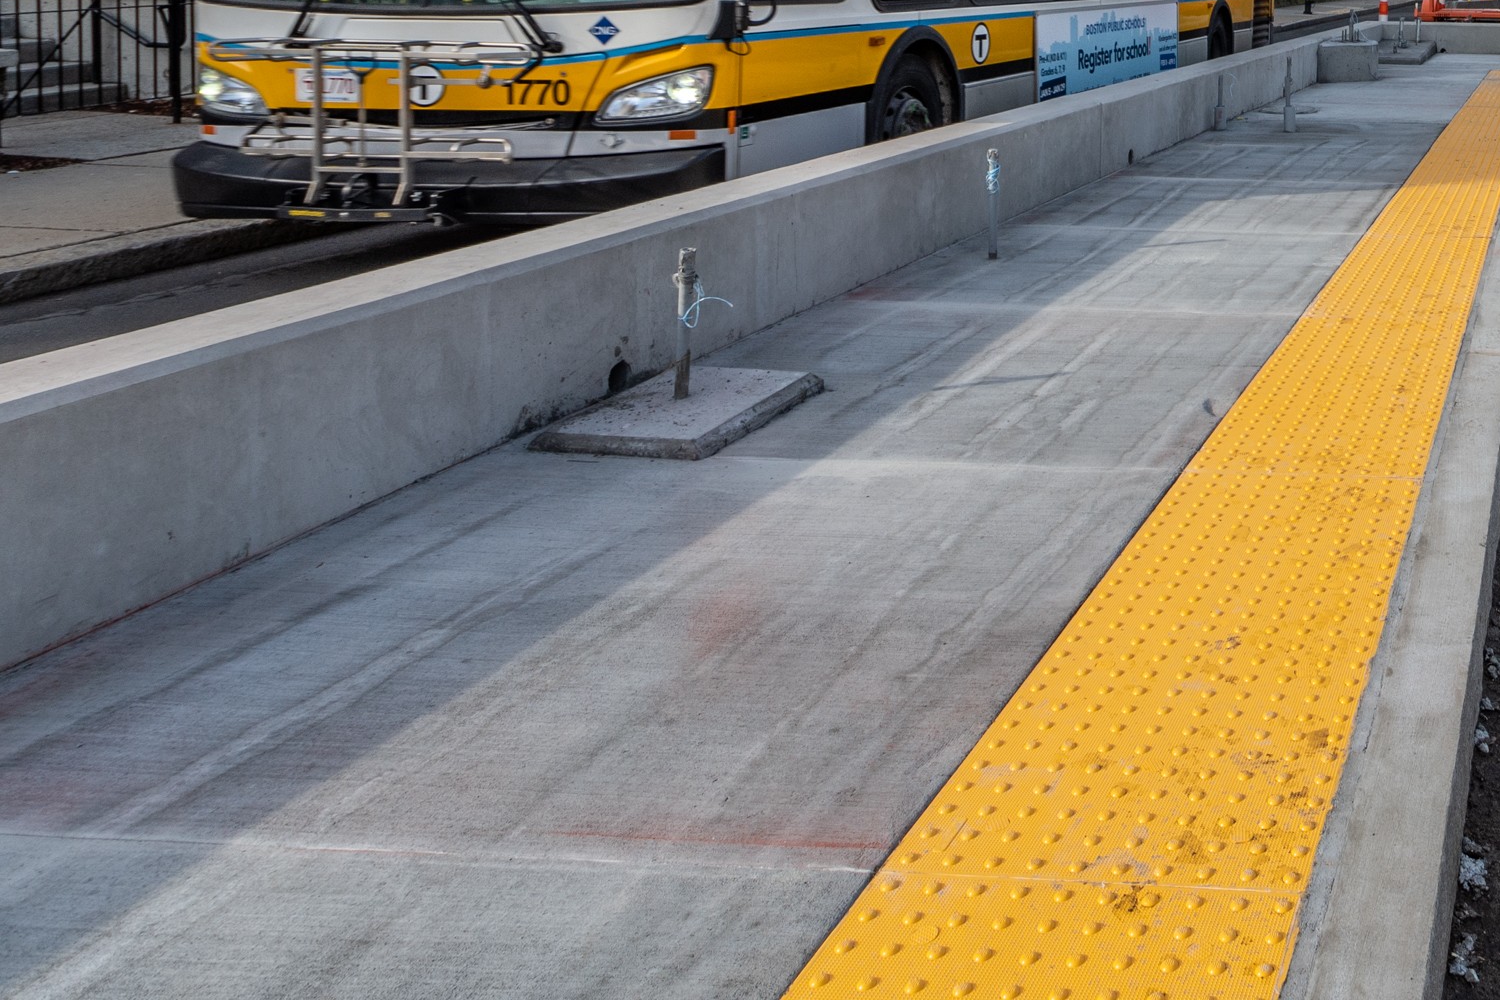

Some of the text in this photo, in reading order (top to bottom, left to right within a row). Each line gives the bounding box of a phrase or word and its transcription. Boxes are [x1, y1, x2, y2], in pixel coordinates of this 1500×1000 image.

[592, 26, 617, 36] CNG
[1086, 18, 1145, 35] BOSTON PUBLIC SCHOOLS
[975, 34, 986, 58] T
[1078, 36, 1151, 74] Register for school!
[1041, 67, 1054, 76] Grades
[502, 78, 570, 106] 1770
